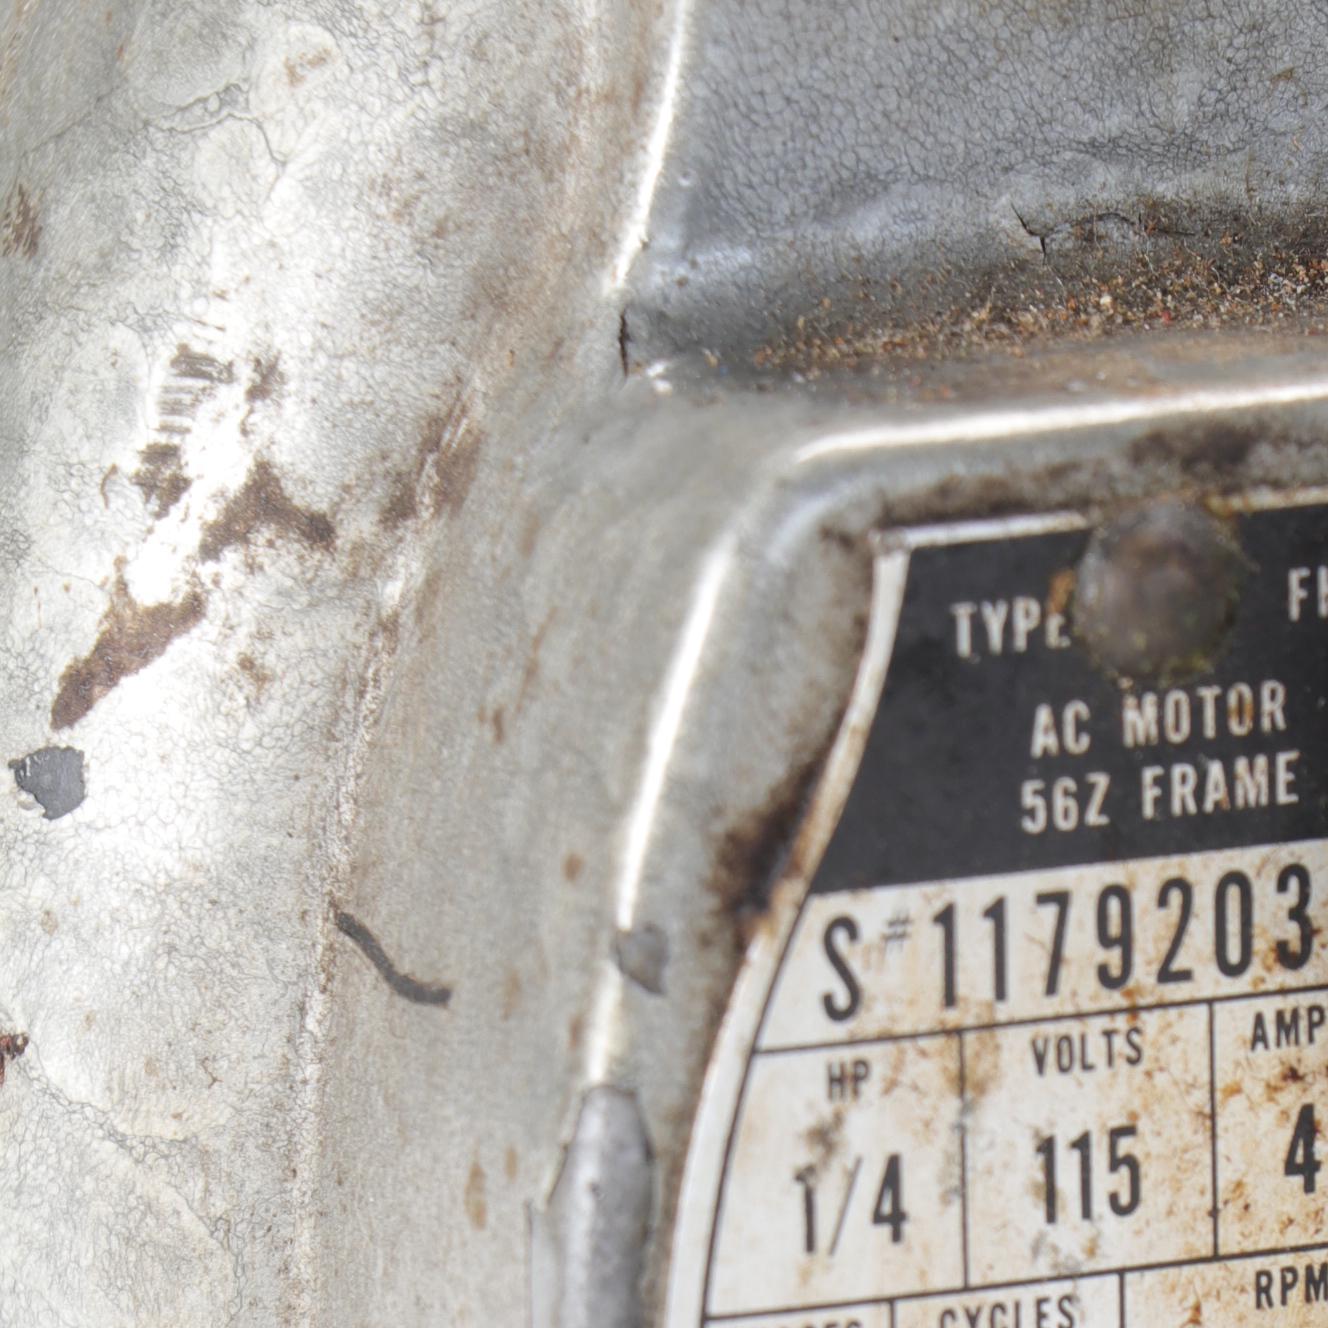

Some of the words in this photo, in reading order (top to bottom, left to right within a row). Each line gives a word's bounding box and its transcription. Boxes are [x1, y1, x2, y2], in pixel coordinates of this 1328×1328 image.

[949, 596, 1071, 659] TYPE
[1031, 700, 1091, 759] AC
[1122, 679, 1287, 748] MOTOR
[1021, 773, 1110, 835] 56Z
[1141, 750, 1301, 820] FRAME
[827, 1058, 869, 1101] HP
[1030, 1028, 1142, 1077] VOLTS
[794, 1153, 908, 1254] 1/4
[1035, 1124, 1141, 1224] 115
